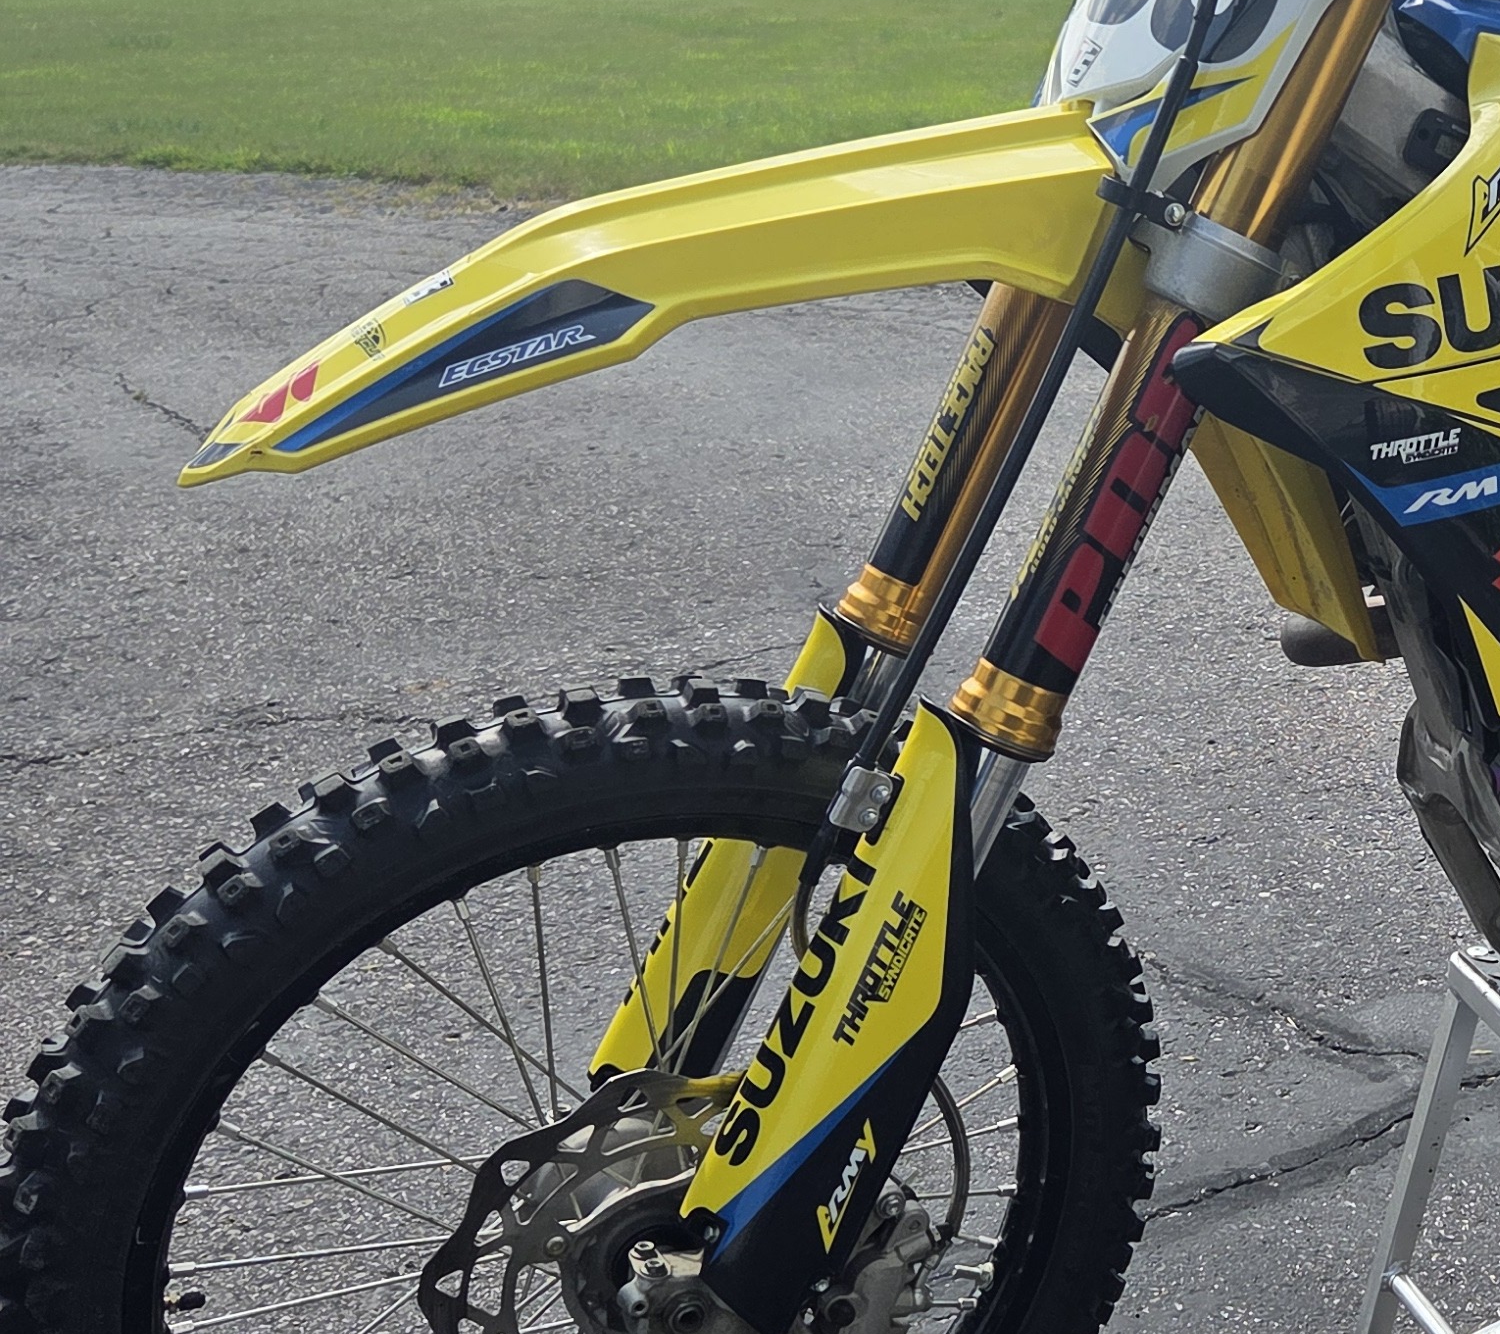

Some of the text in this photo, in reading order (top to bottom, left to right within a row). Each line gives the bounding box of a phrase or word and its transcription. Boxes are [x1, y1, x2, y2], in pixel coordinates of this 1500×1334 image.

[438, 324, 597, 389] ECSTAR
[1370, 427, 1462, 463] THROTTLE
[832, 890, 918, 1047] THROTTLE
[878, 906, 927, 1001] SYNDICATE
[716, 854, 877, 1167] SUZUKI
